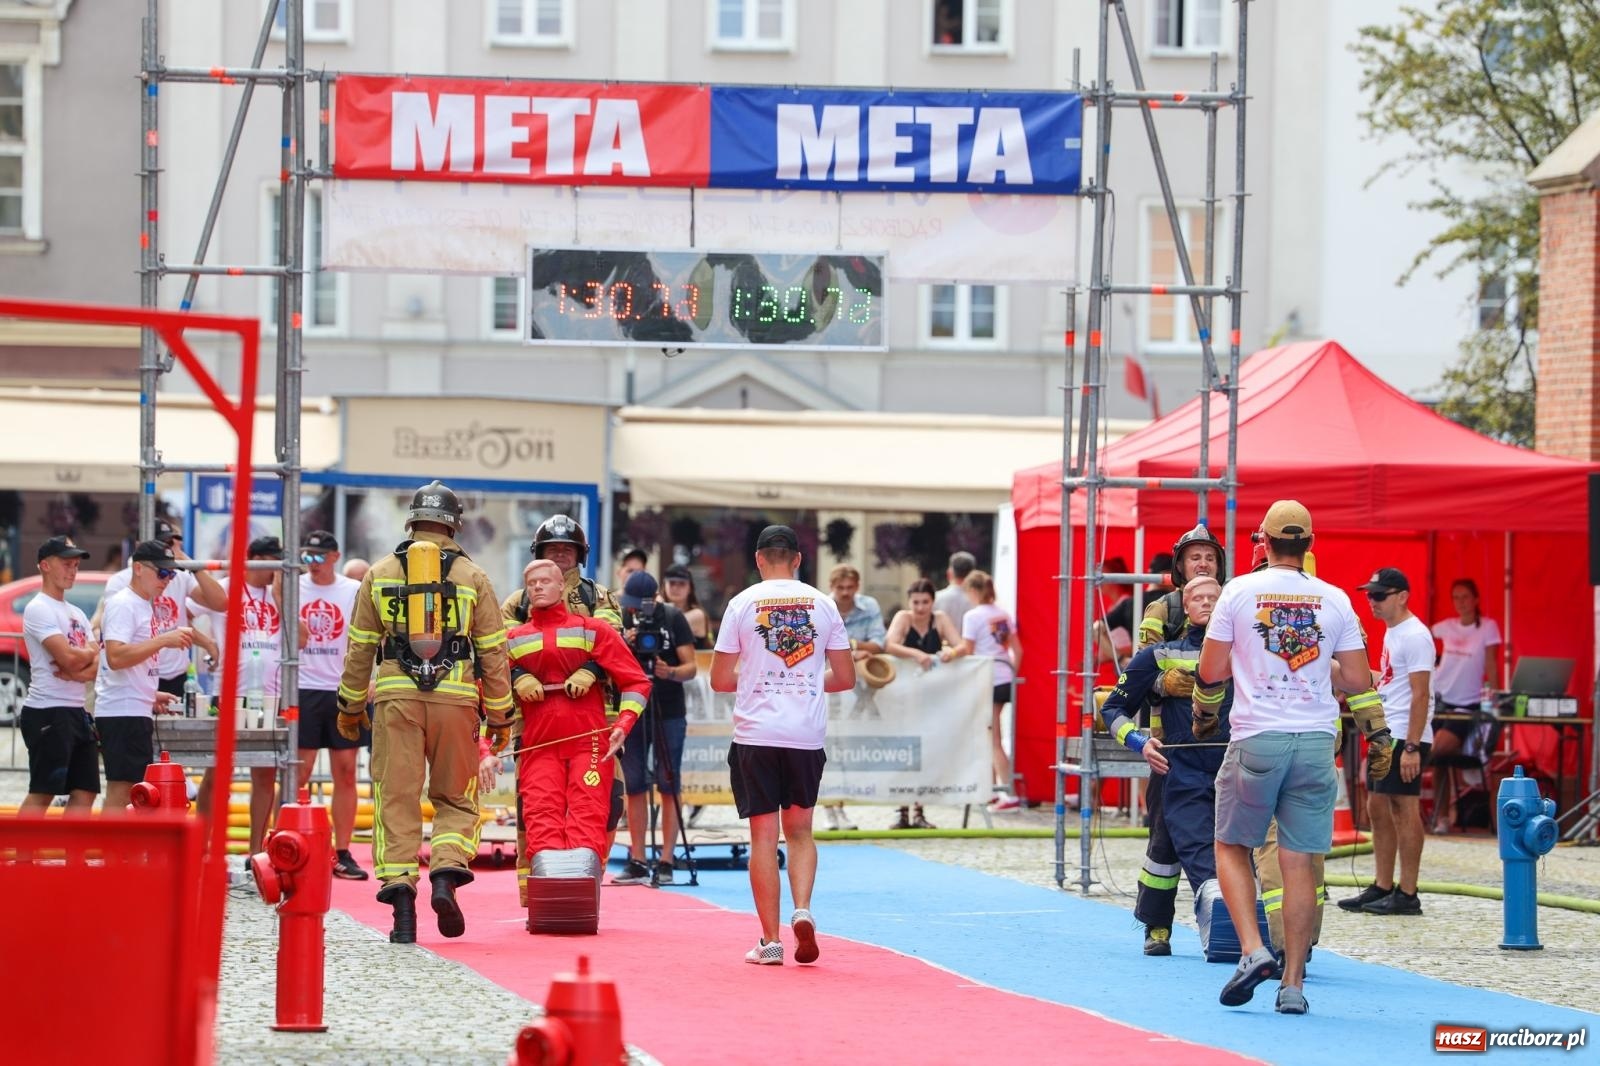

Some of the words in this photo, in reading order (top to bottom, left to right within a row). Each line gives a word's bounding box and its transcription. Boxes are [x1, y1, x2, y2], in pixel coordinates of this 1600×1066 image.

[389, 92, 651, 177] META
[776, 104, 1034, 185] META
[1256, 593, 1323, 602] TOUGHEST
[785, 643, 814, 667] 2023
[1289, 646, 1319, 670] 2023
[830, 744, 914, 766] brukowej
